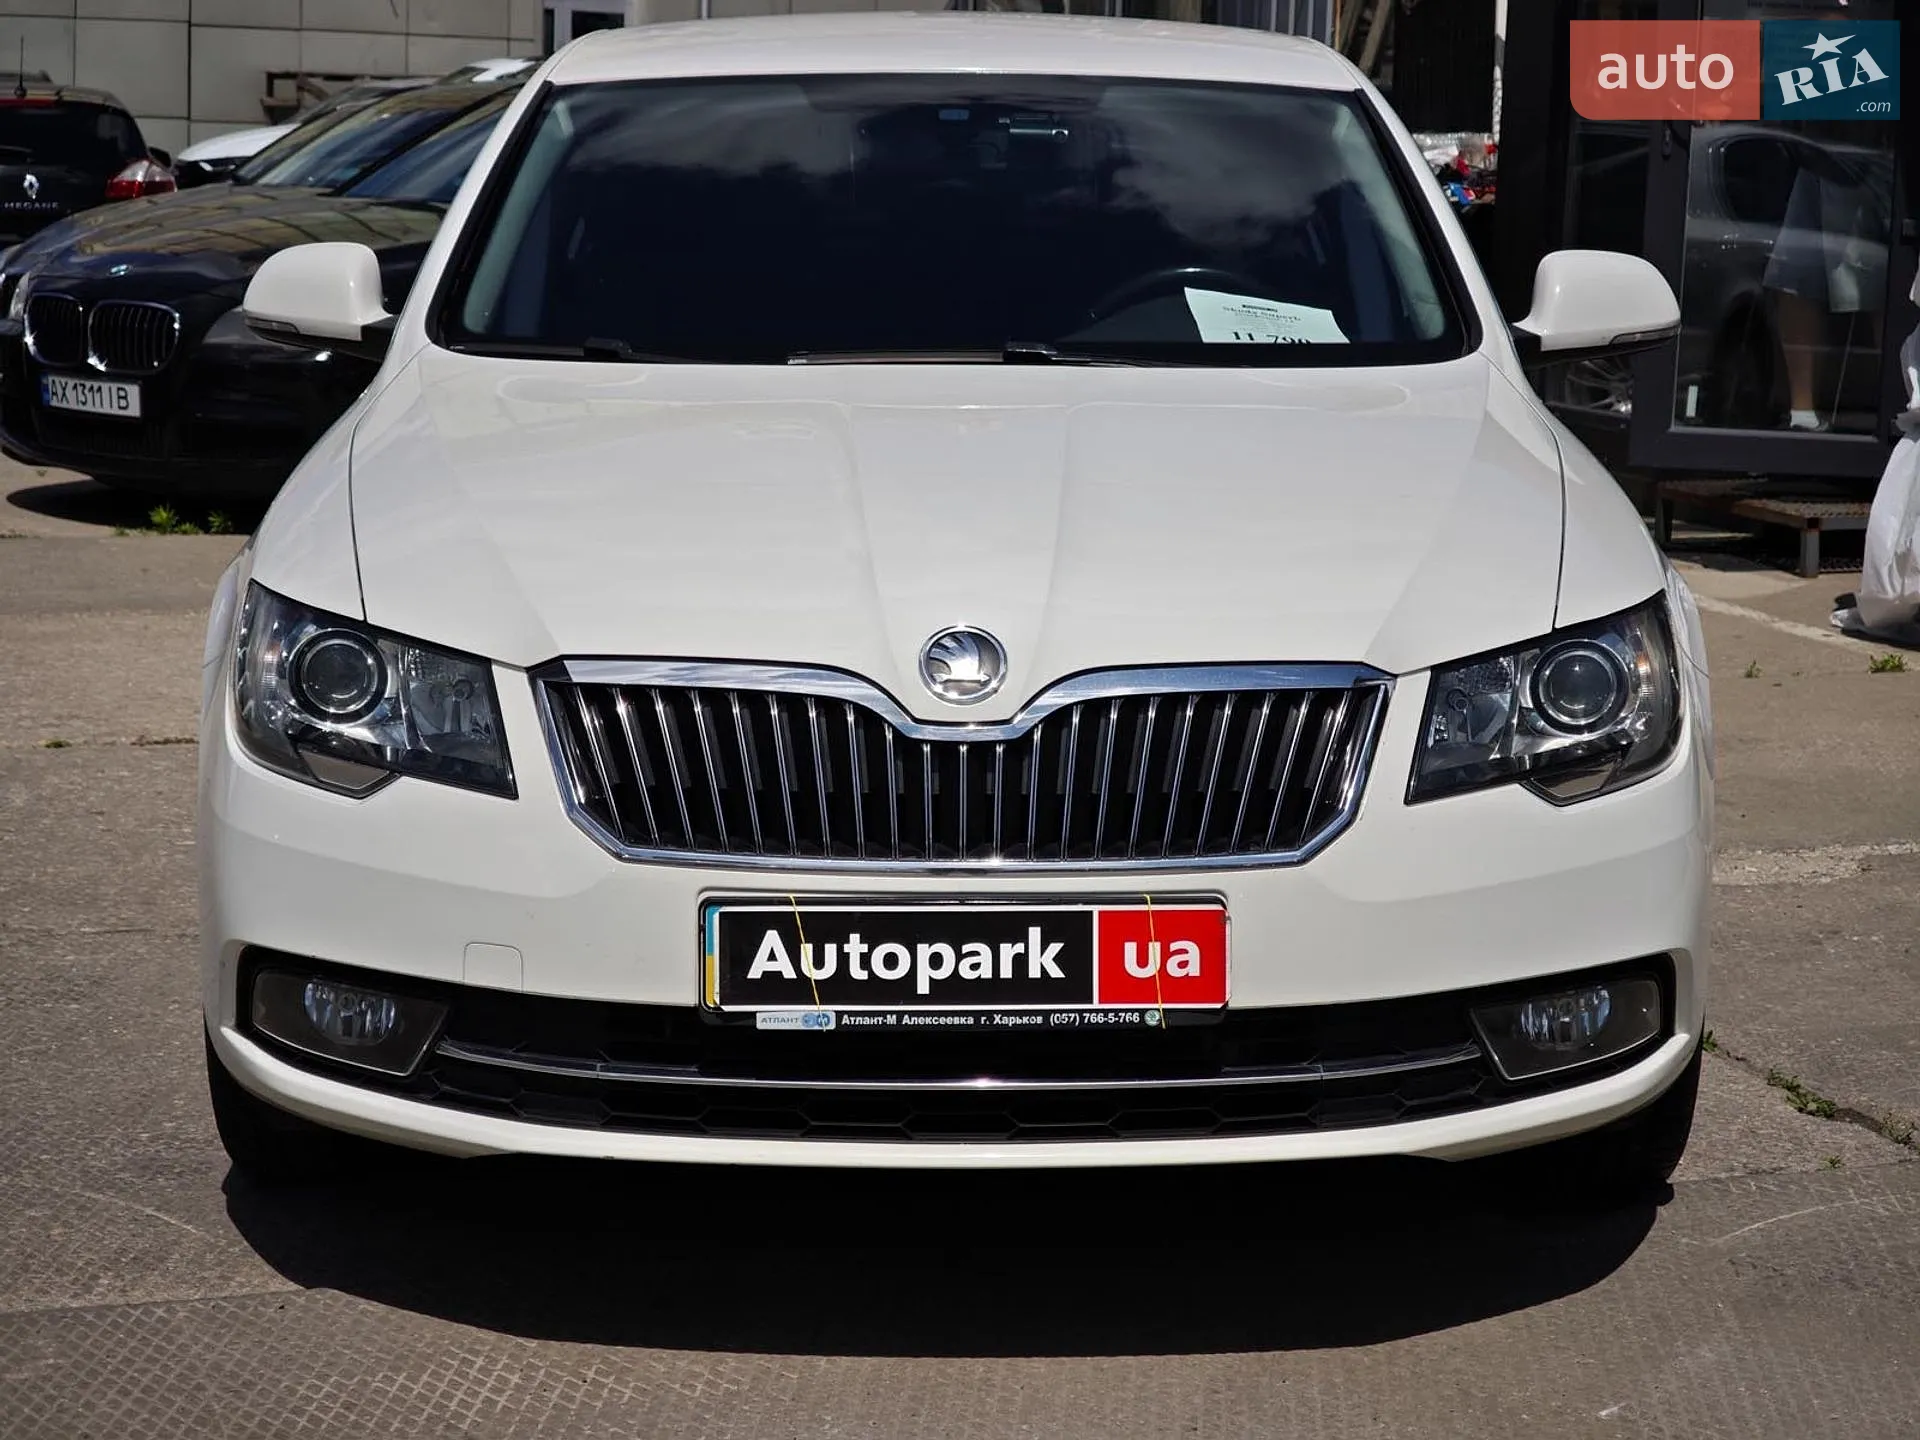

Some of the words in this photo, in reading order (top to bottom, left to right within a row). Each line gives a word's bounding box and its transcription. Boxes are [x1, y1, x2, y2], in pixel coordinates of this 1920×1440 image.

[51, 379, 70, 405] AX
[72, 382, 105, 409] 1311
[108, 385, 130, 411] IB
[746, 926, 1066, 995] Autopark
[1123, 940, 1201, 979] ua
[841, 1014, 897, 1026] Атлант-М
[902, 1014, 974, 1026] Алексеевка
[980, 1016, 990, 1026] г.
[993, 1013, 1044, 1026] Харьков
[1049, 1012, 1080, 1026] (057)
[1083, 1012, 1140, 1024] 766-5-766
